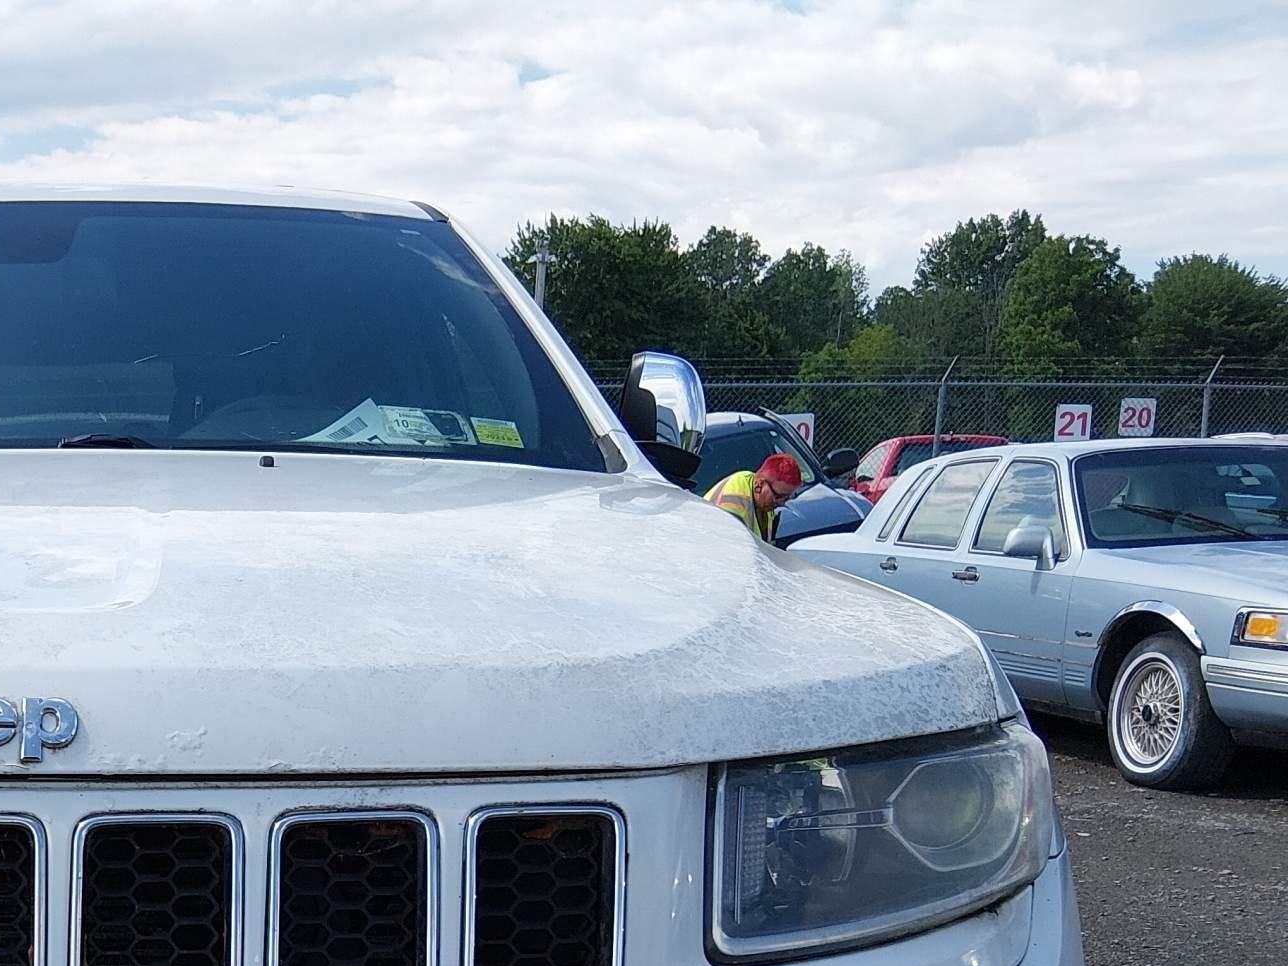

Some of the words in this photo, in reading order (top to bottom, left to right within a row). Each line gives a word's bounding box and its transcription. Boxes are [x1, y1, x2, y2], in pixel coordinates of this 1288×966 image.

[394, 419, 409, 429] 10
[1057, 411, 1089, 437] 21
[1121, 406, 1152, 429] 20
